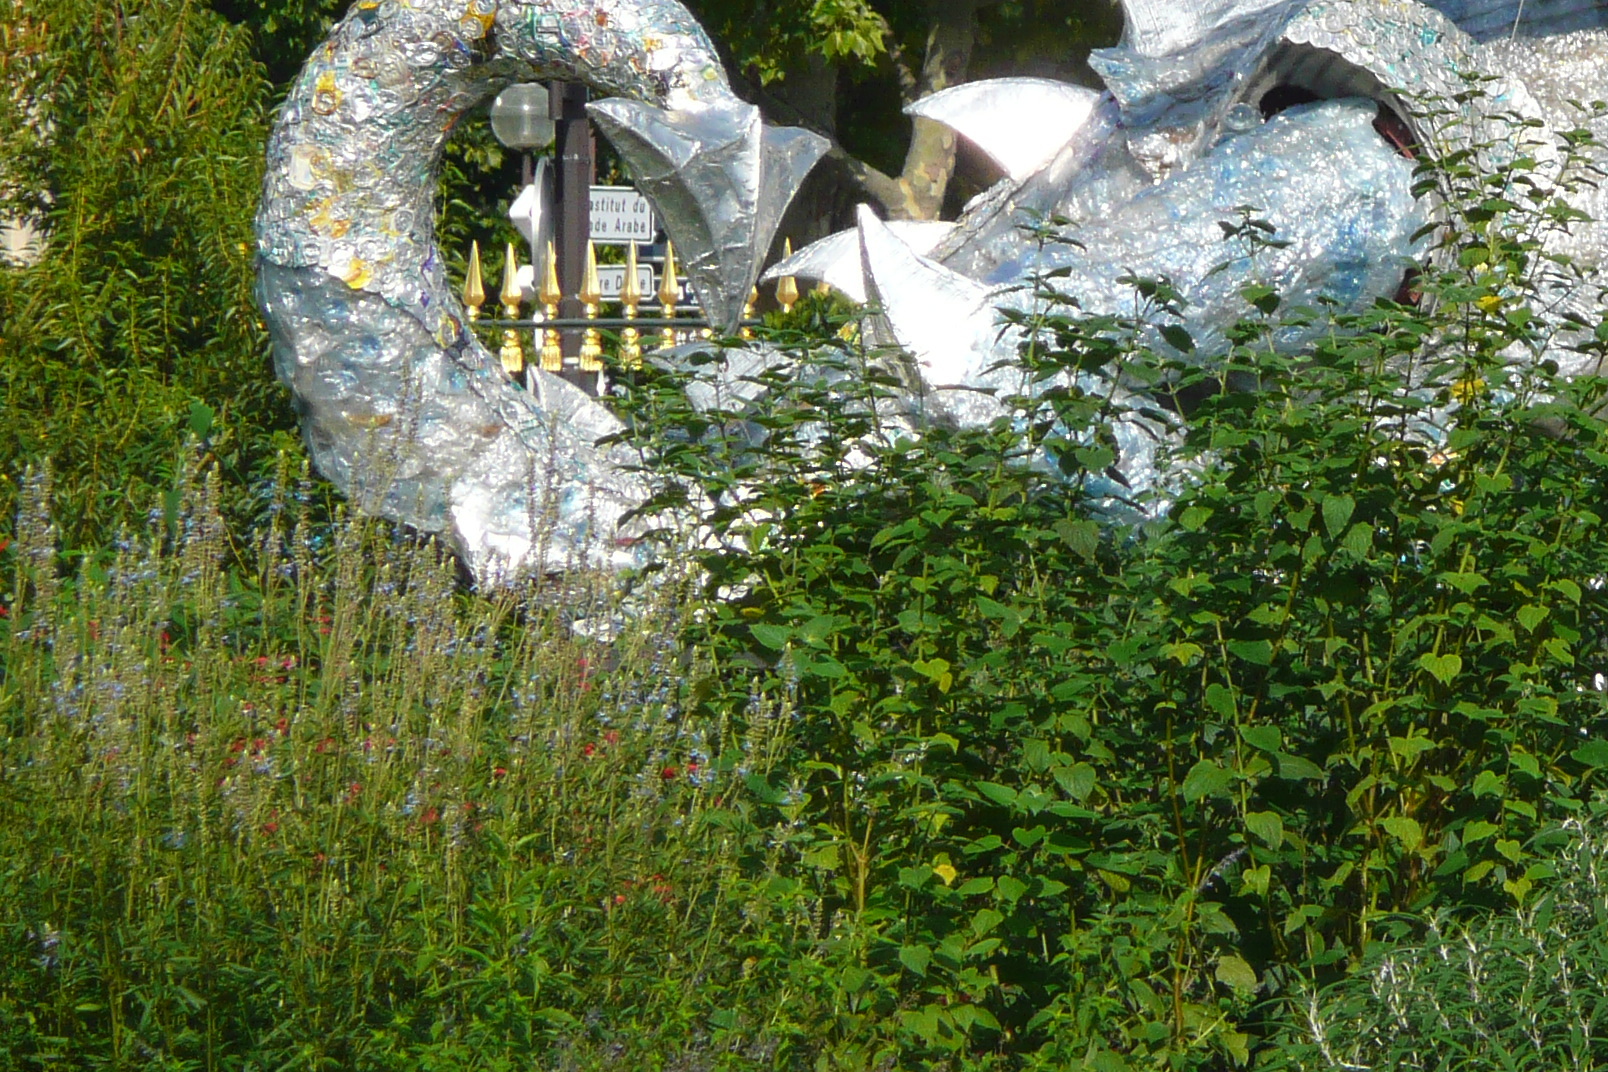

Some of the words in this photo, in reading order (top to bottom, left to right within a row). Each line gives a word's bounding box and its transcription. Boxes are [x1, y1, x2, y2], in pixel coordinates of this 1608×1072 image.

[590, 197, 626, 212] nstitut
[632, 197, 645, 213] du
[614, 217, 645, 233] Arabe
